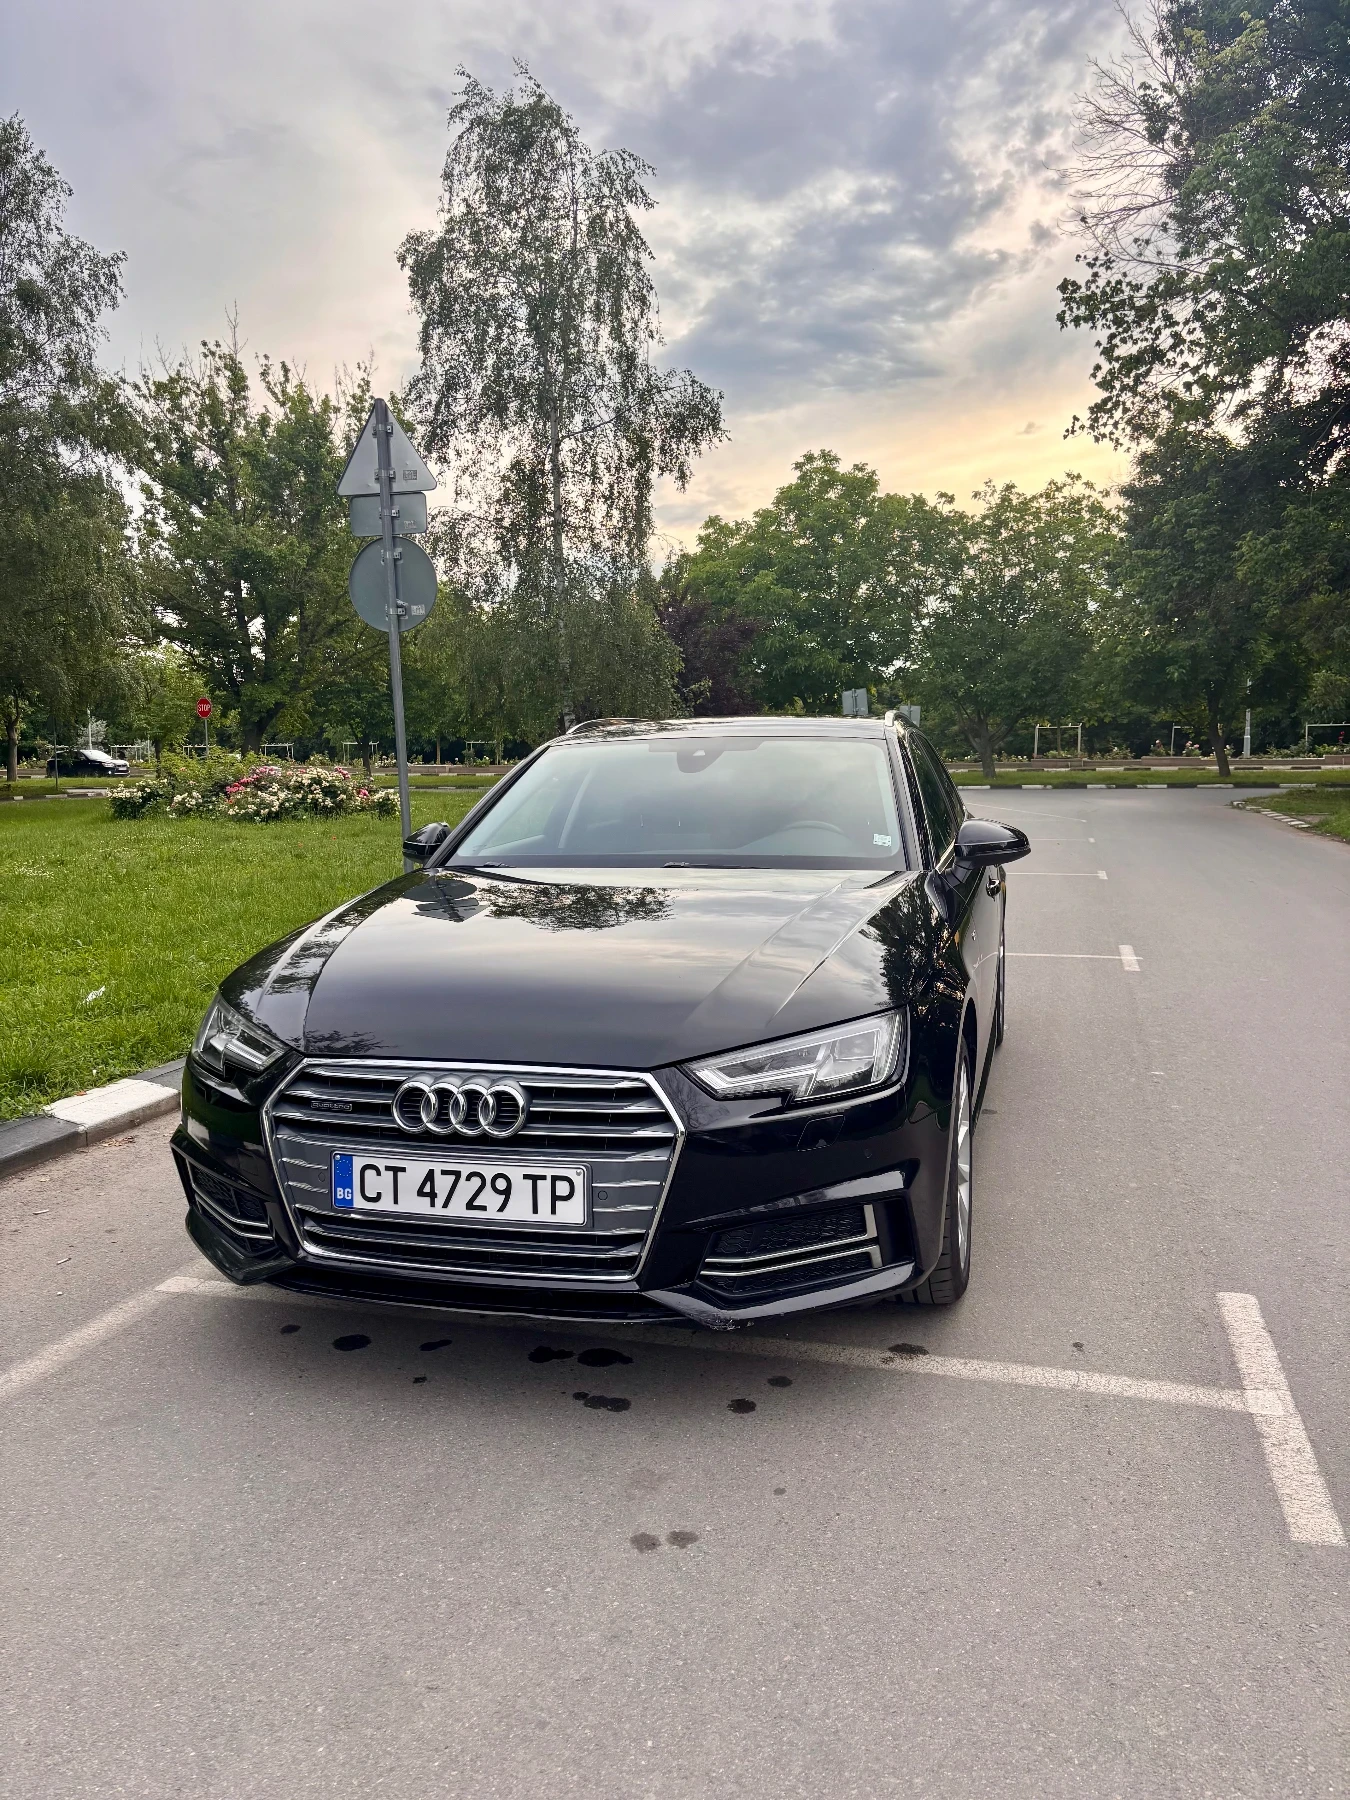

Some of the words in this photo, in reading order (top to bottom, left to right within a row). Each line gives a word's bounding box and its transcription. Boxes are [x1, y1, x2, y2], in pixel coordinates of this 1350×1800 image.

[198, 704, 211, 712] STOP
[336, 1187, 352, 1200] BG
[359, 1163, 407, 1205] CT
[416, 1168, 513, 1213] 4729
[523, 1173, 575, 1216] TP
